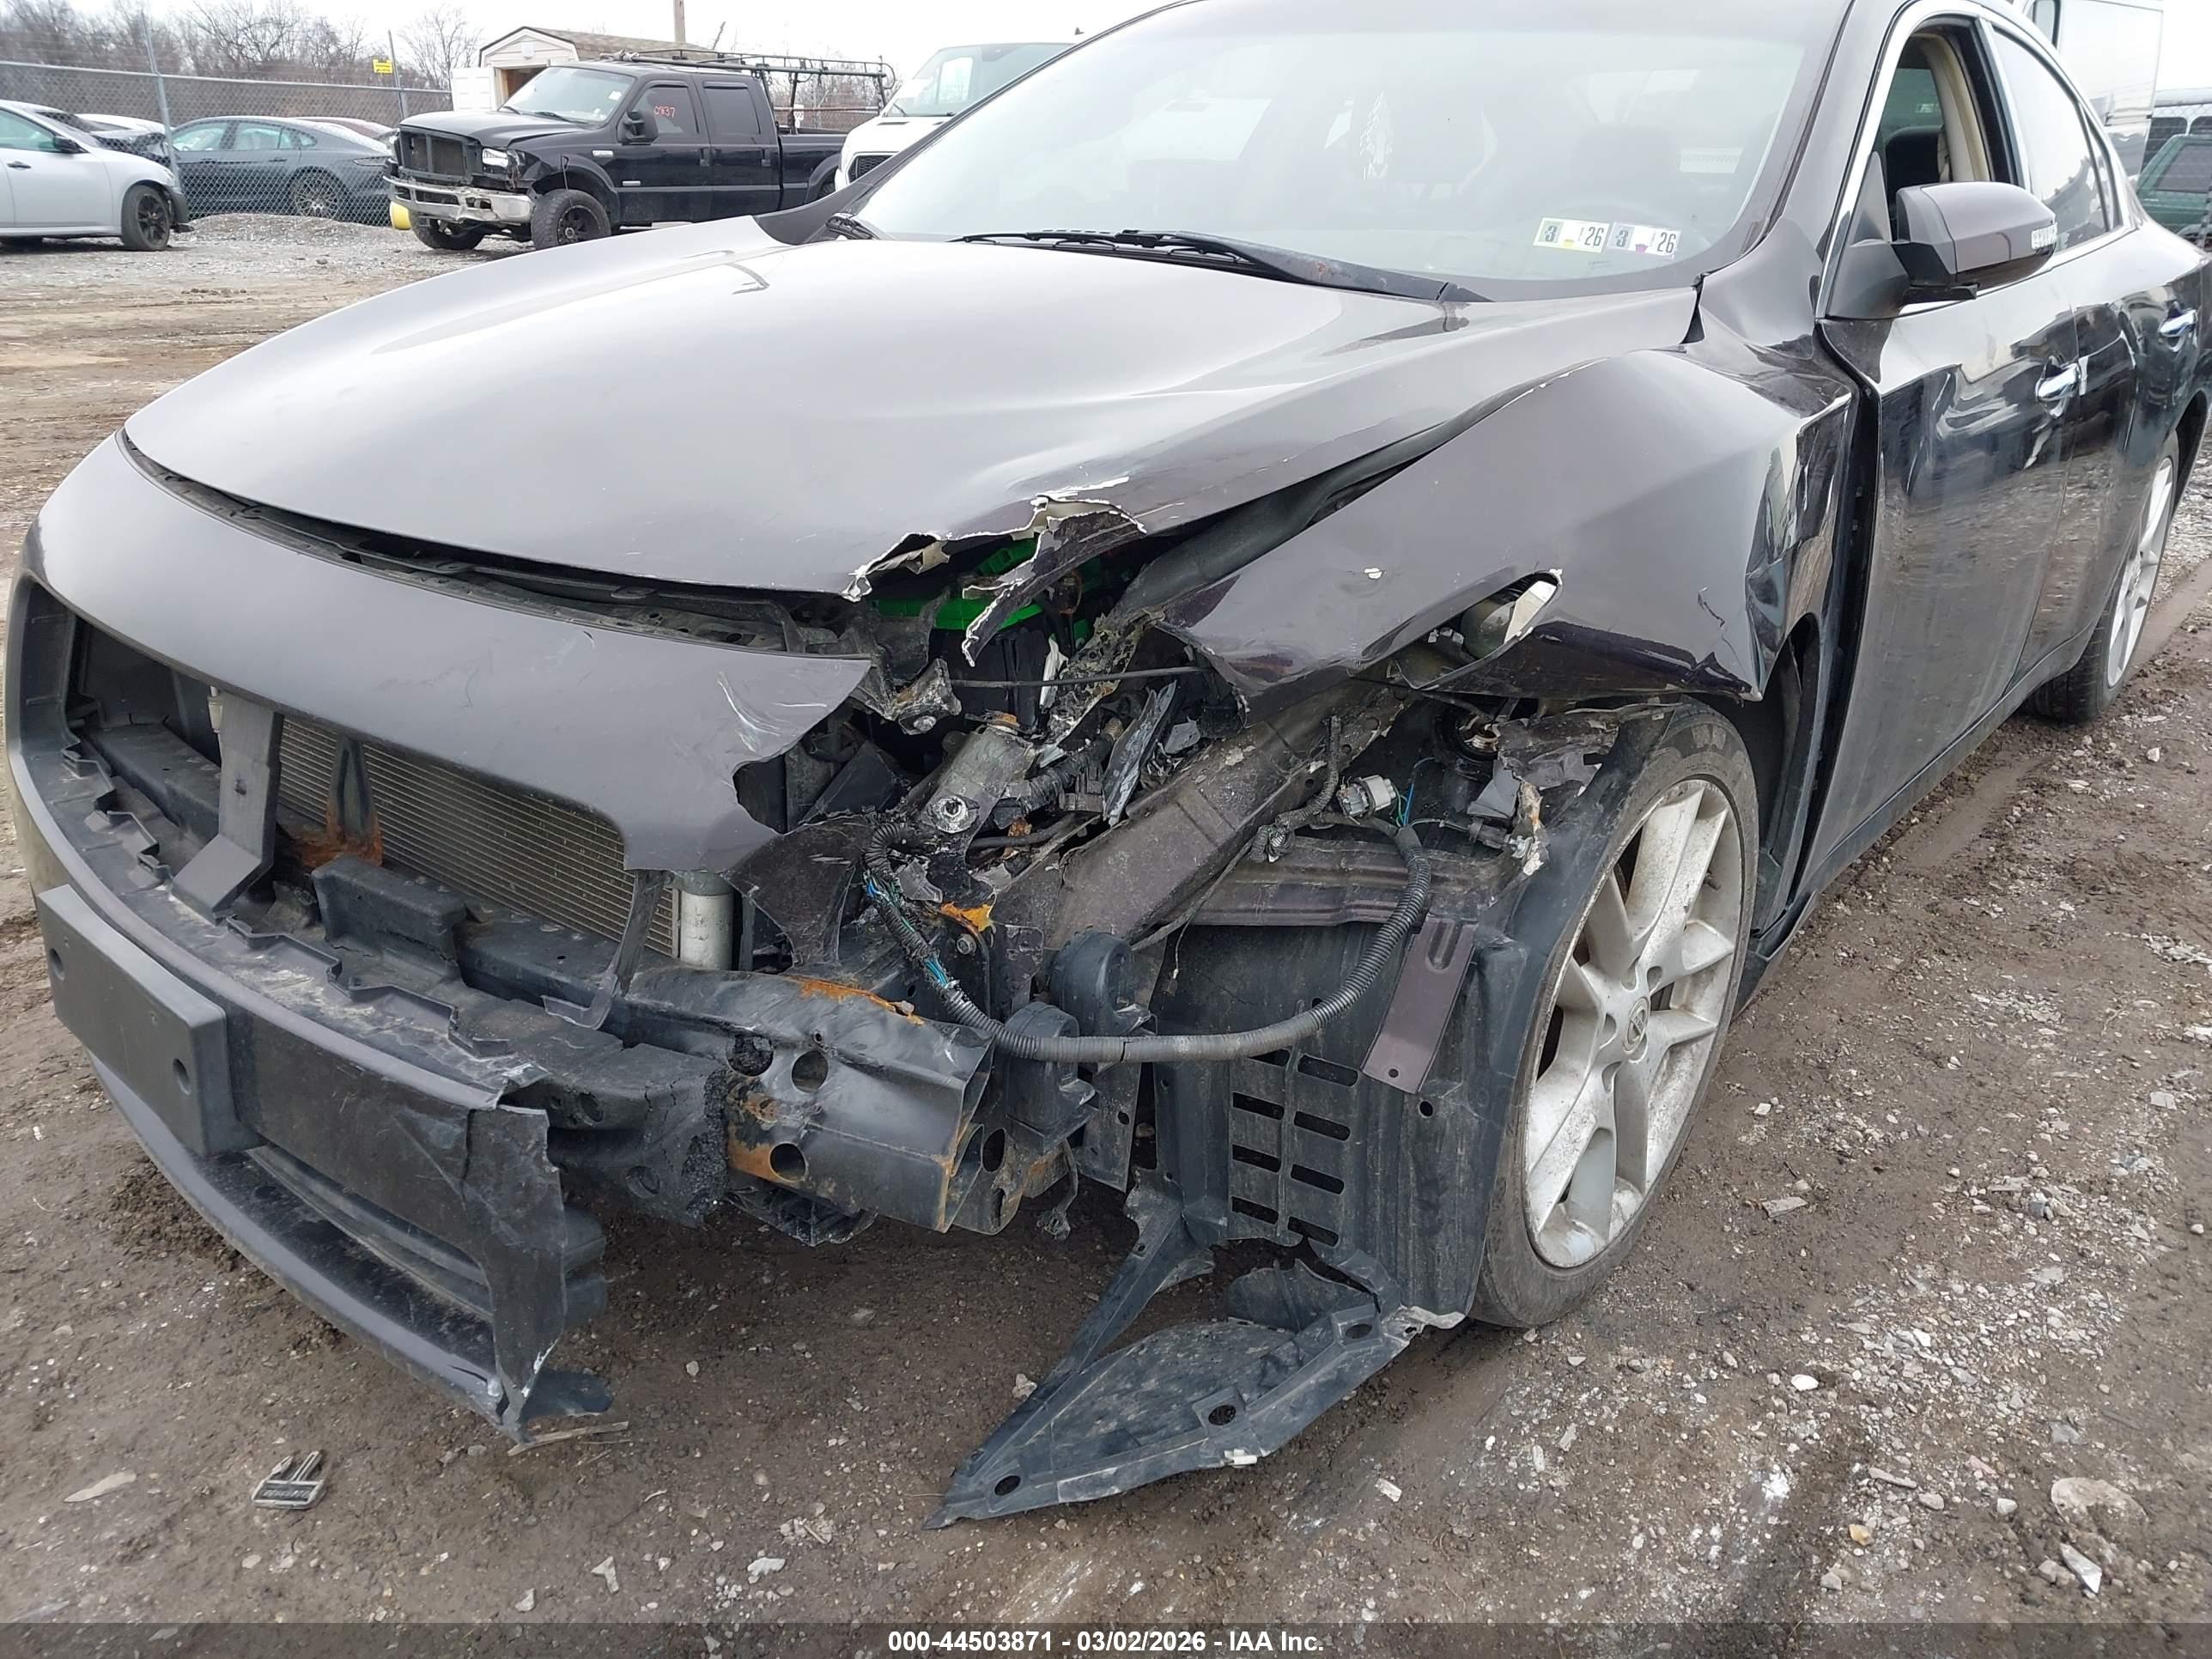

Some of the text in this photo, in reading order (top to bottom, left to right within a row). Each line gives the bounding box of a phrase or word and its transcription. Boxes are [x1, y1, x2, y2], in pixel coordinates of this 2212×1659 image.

[1545, 226, 1558, 241] 3
[1584, 227, 1604, 246] 26
[1616, 230, 1629, 247] 3
[1657, 232, 1676, 253] 26
